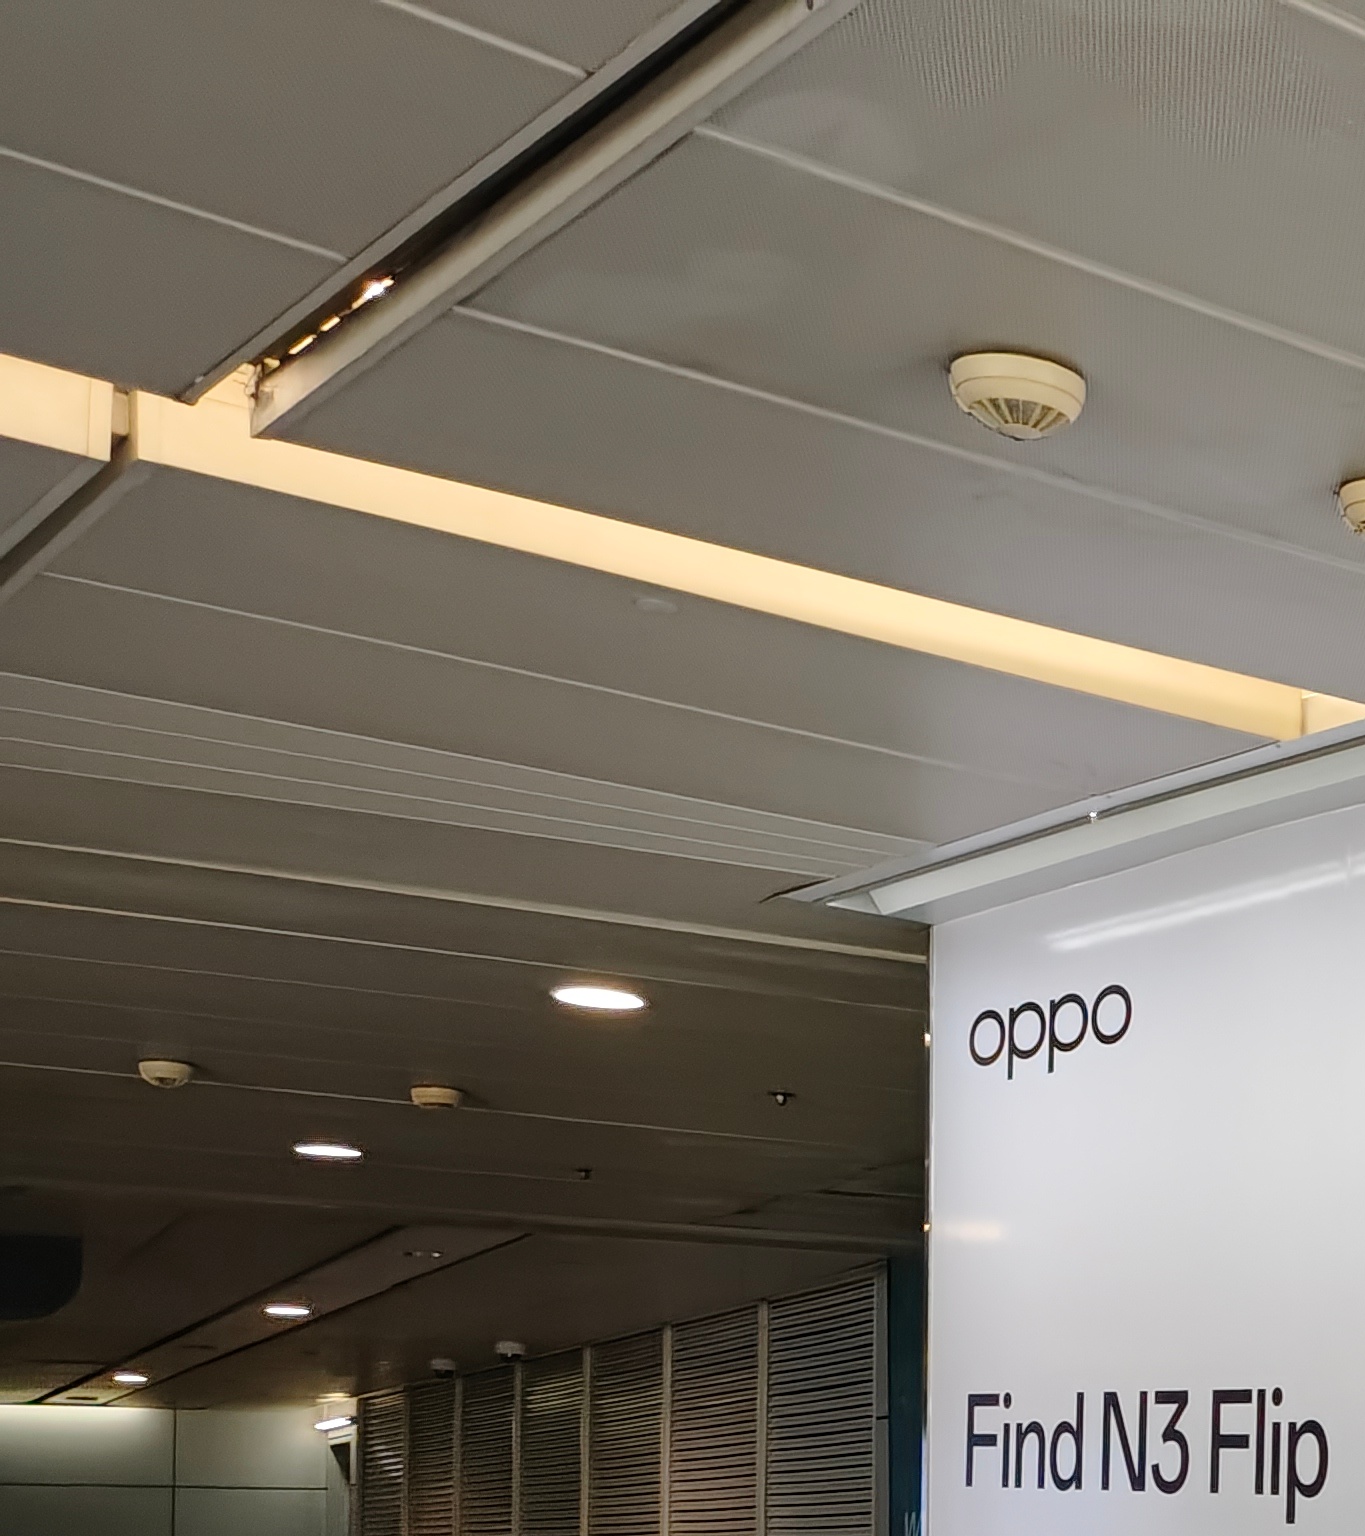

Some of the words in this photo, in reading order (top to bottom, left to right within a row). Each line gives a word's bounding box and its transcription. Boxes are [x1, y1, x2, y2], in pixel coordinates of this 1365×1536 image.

[965, 1391, 1085, 1491] Find
[1101, 1390, 1190, 1494] N3
[1209, 1386, 1329, 1524] Flip
